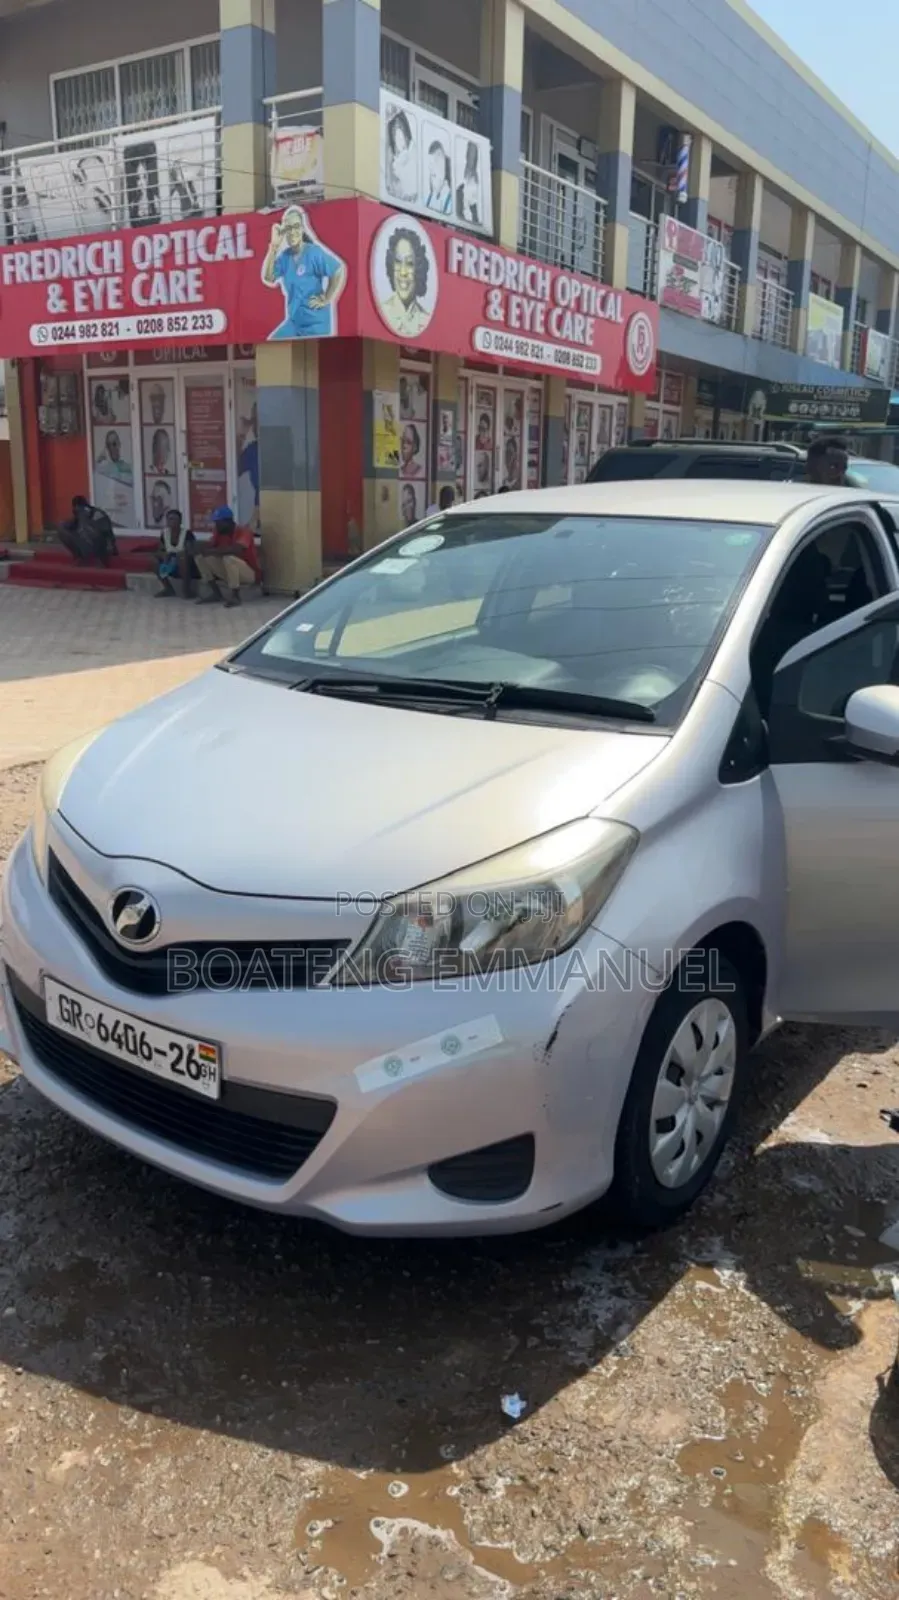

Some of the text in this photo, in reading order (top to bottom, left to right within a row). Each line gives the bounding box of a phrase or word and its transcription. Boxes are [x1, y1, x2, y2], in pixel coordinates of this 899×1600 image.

[3, 223, 254, 285] FREDRICH OPTICAL
[46, 268, 203, 314] & EYE CARE
[449, 236, 624, 324] FREDRICH OPTICAL
[51, 322, 76, 341] 0244
[78, 320, 100, 339] 982
[101, 318, 120, 337] 821
[136, 315, 163, 334] 0208
[167, 314, 188, 332] 852
[191, 312, 214, 330] 233
[487, 288, 595, 346] & EYE CARE
[58, 994, 84, 1032] GR
[200, 1063, 216, 1082] GH
